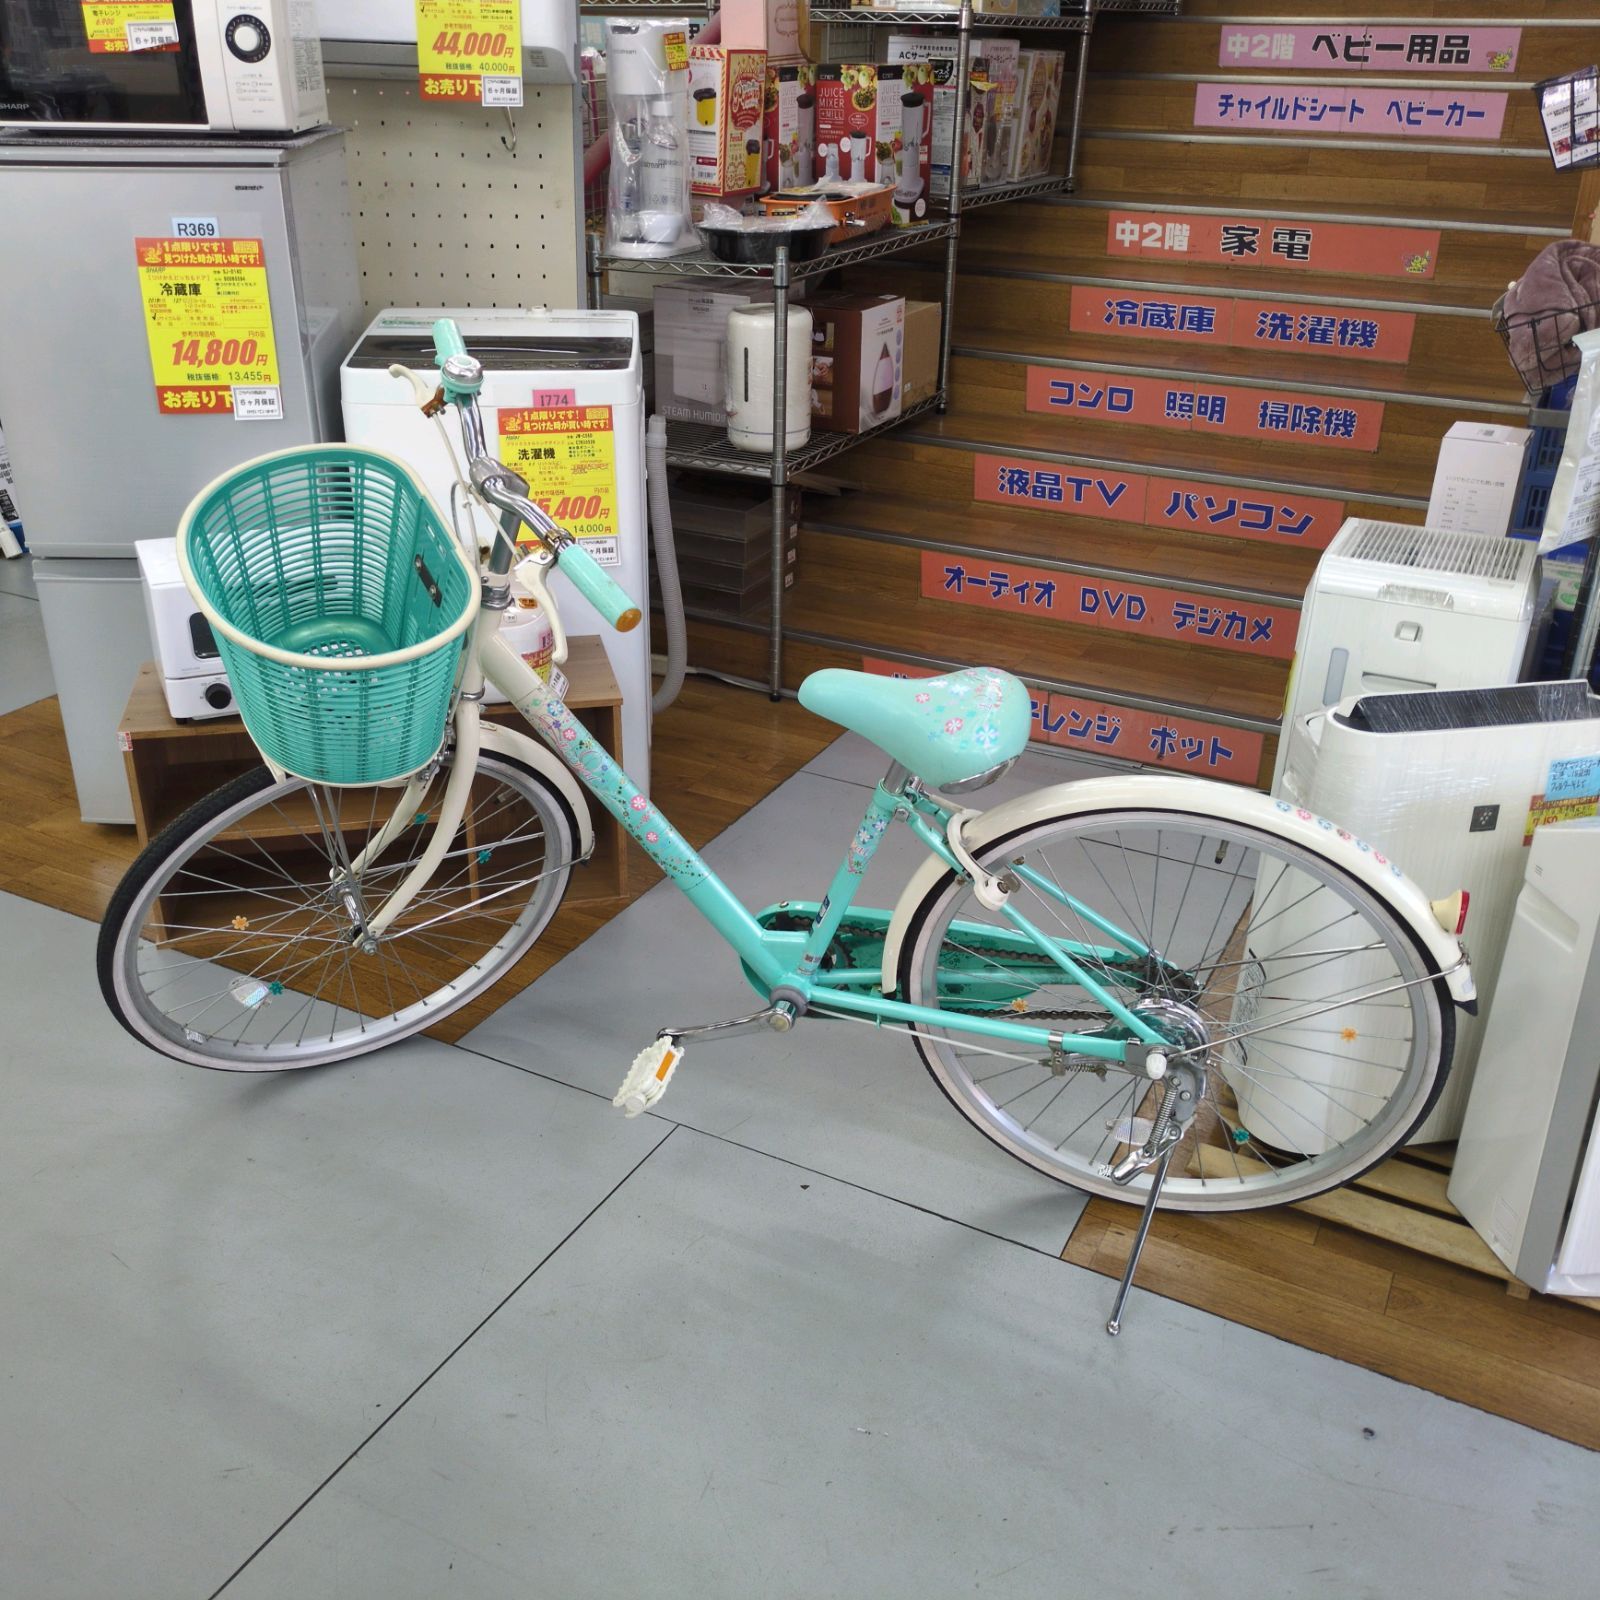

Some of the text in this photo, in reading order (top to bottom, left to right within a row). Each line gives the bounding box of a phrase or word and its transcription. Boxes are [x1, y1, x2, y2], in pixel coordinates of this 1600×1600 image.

[1227, 33, 1471, 65] 中2階 ベビー用品
[819, 87, 844, 97] JUICE
[819, 98, 844, 108] MIXER
[1218, 94, 1486, 127] チャイルドシート ベビーカー
[177, 223, 216, 237] R369
[1115, 220, 1192, 252] 中2階
[160, 282, 202, 296] 冷蔵庫
[1103, 299, 1379, 349] 冷蔵庫 洗濯機
[661, 405, 691, 418] STEAM
[1049, 380, 1359, 439] コンロ 照明 掃除機
[518, 448, 556, 460] 洗濯機
[996, 466, 1316, 537] 液晶TV パソコン
[943, 565, 1275, 643] オーディオ DVD デジカメ
[1149, 726, 1233, 766] ポット
